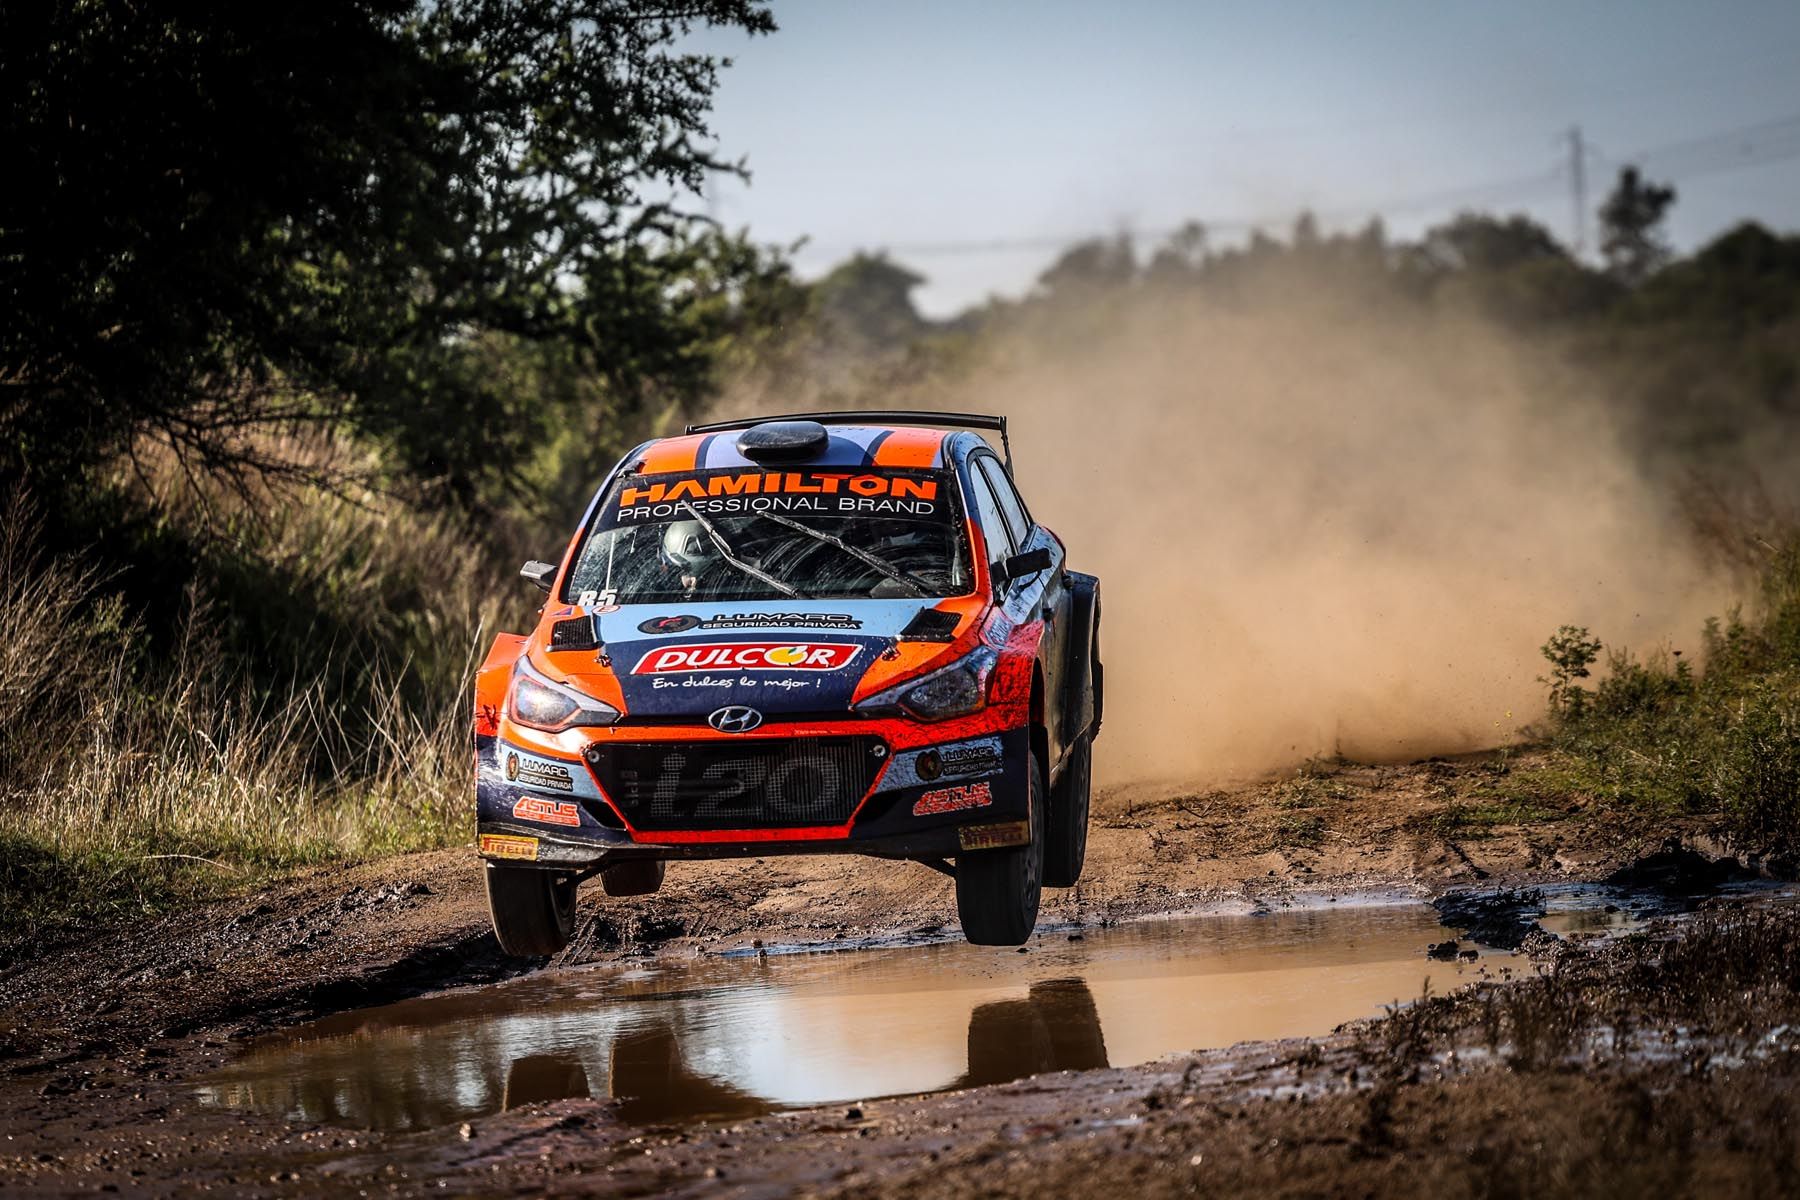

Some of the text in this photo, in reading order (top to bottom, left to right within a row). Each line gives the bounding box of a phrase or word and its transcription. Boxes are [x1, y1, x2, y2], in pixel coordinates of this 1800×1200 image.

[619, 473, 937, 507] HAMILTON
[617, 497, 935, 522] PROFESSIONAL BRAND
[577, 588, 618, 607] R5
[702, 621, 858, 630] SEGURIDAD PRIVADA
[717, 613, 849, 622] LUMARC
[655, 645, 836, 669] DULCOR
[652, 677, 679, 689] En
[681, 675, 734, 688] dulces
[739, 675, 757, 687] lo
[763, 677, 810, 691] mejor
[651, 752, 840, 818] i20
[515, 797, 579, 817] ASTUS
[482, 836, 535, 856] PIRELLI
